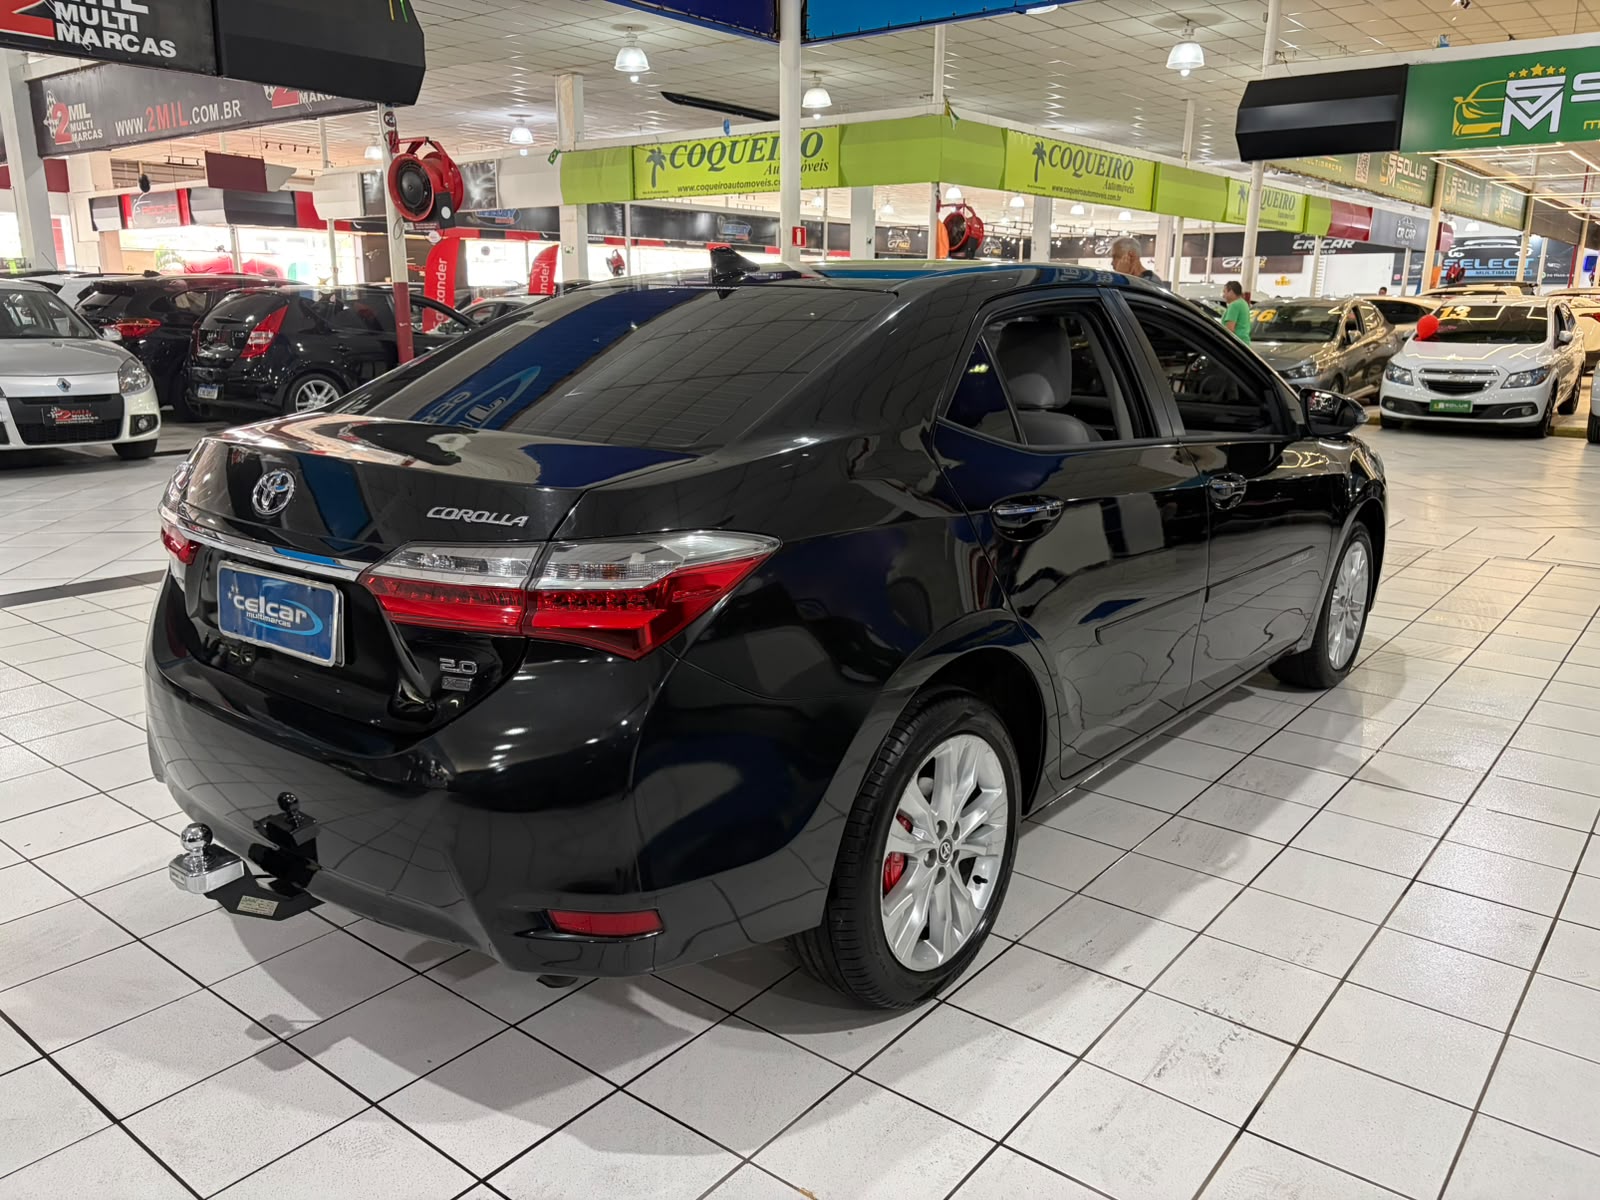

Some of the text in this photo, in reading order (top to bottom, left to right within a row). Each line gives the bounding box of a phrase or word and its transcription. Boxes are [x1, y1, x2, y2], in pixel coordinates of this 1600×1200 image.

[54, 1, 139, 33] MULTI
[56, 22, 177, 58] MARCAS
[68, 102, 91, 122] MIL
[115, 99, 242, 137] WWW.2MIL.COM.BR
[70, 119, 93, 132] MULTI
[71, 128, 103, 143] MARCAS
[669, 132, 824, 172] COQUEIO
[763, 158, 830, 177] Auóveis
[1048, 144, 1134, 181] COQUEIRO
[1397, 155, 1428, 181] SOLUS
[1292, 240, 1355, 250] CR CAR
[1443, 258, 1534, 270] SELECT
[427, 507, 530, 527] COROLLA
[233, 595, 307, 625] celcar
[246, 611, 292, 628] multimarcas
